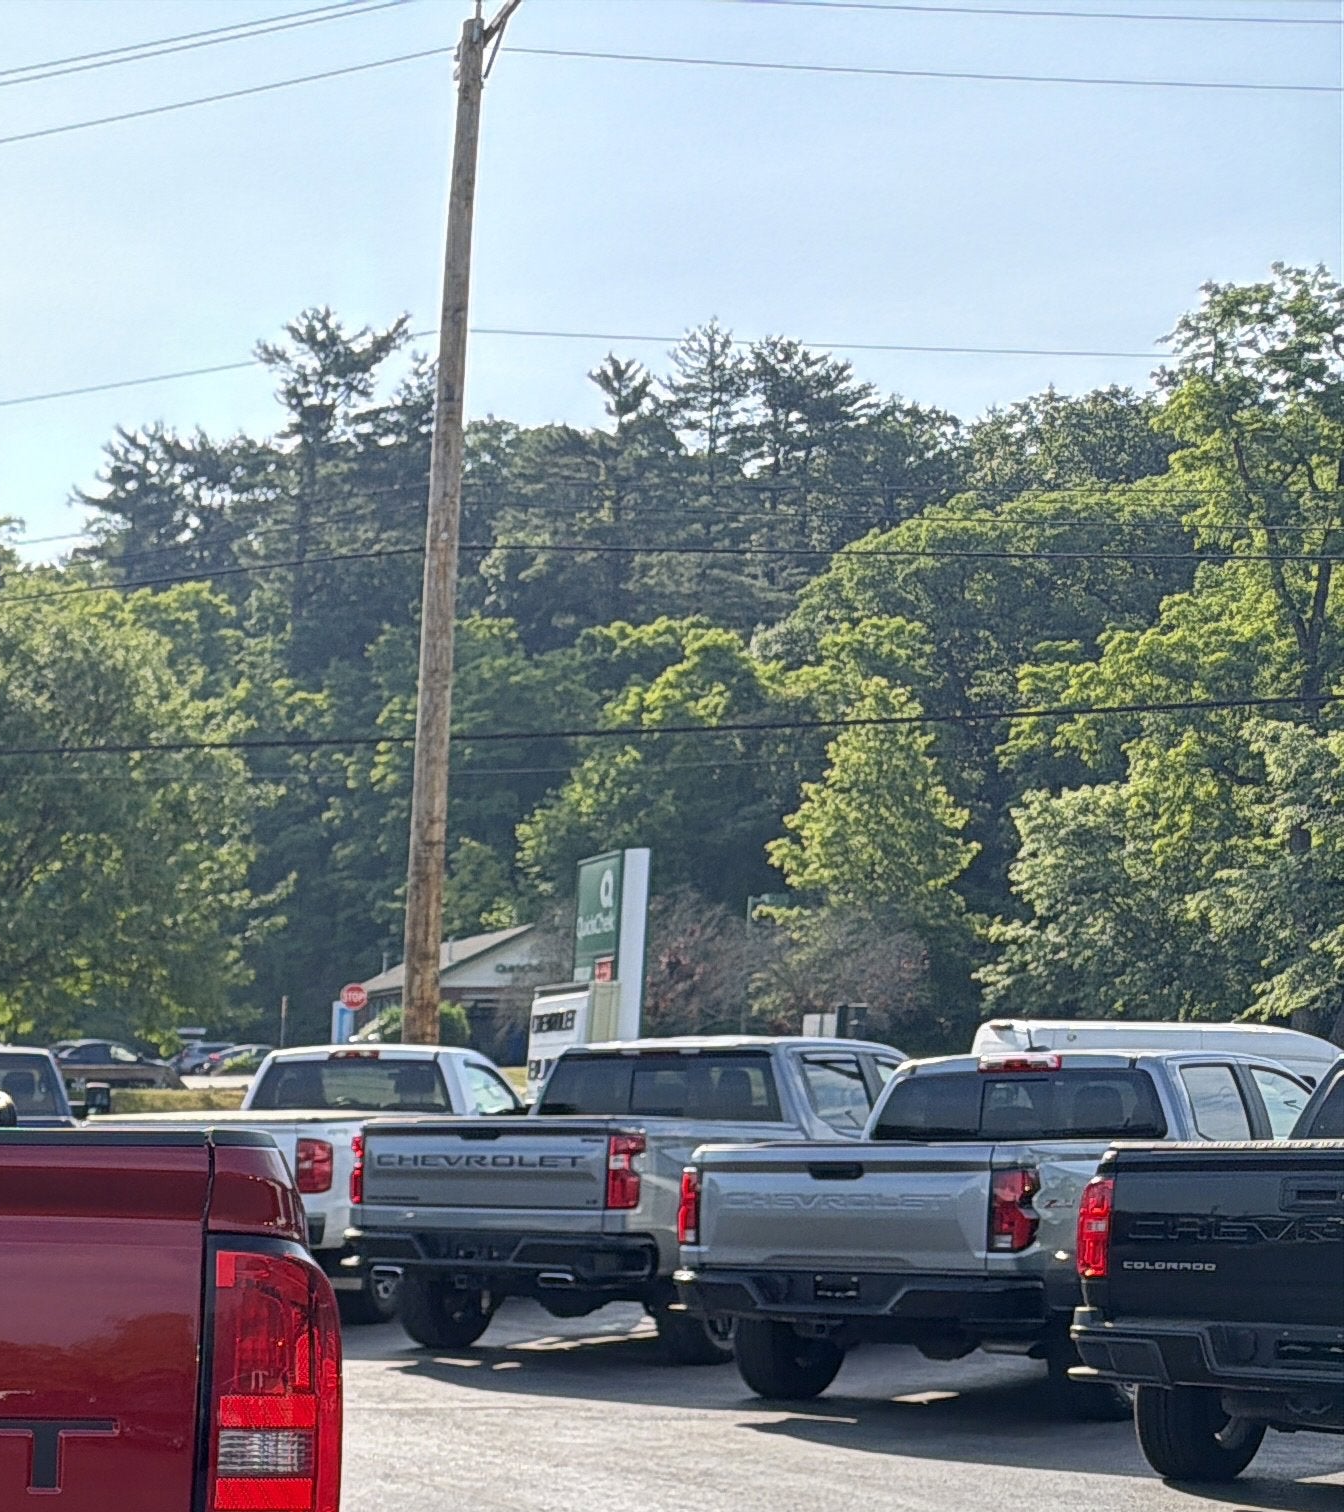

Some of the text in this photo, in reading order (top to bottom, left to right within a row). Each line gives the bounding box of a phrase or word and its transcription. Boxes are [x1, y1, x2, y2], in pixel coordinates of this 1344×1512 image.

[376, 1153, 585, 1170] CHEVROLET
[720, 1191, 952, 1211] CHEVROLET
[1123, 1260, 1217, 1272] COLORADO
